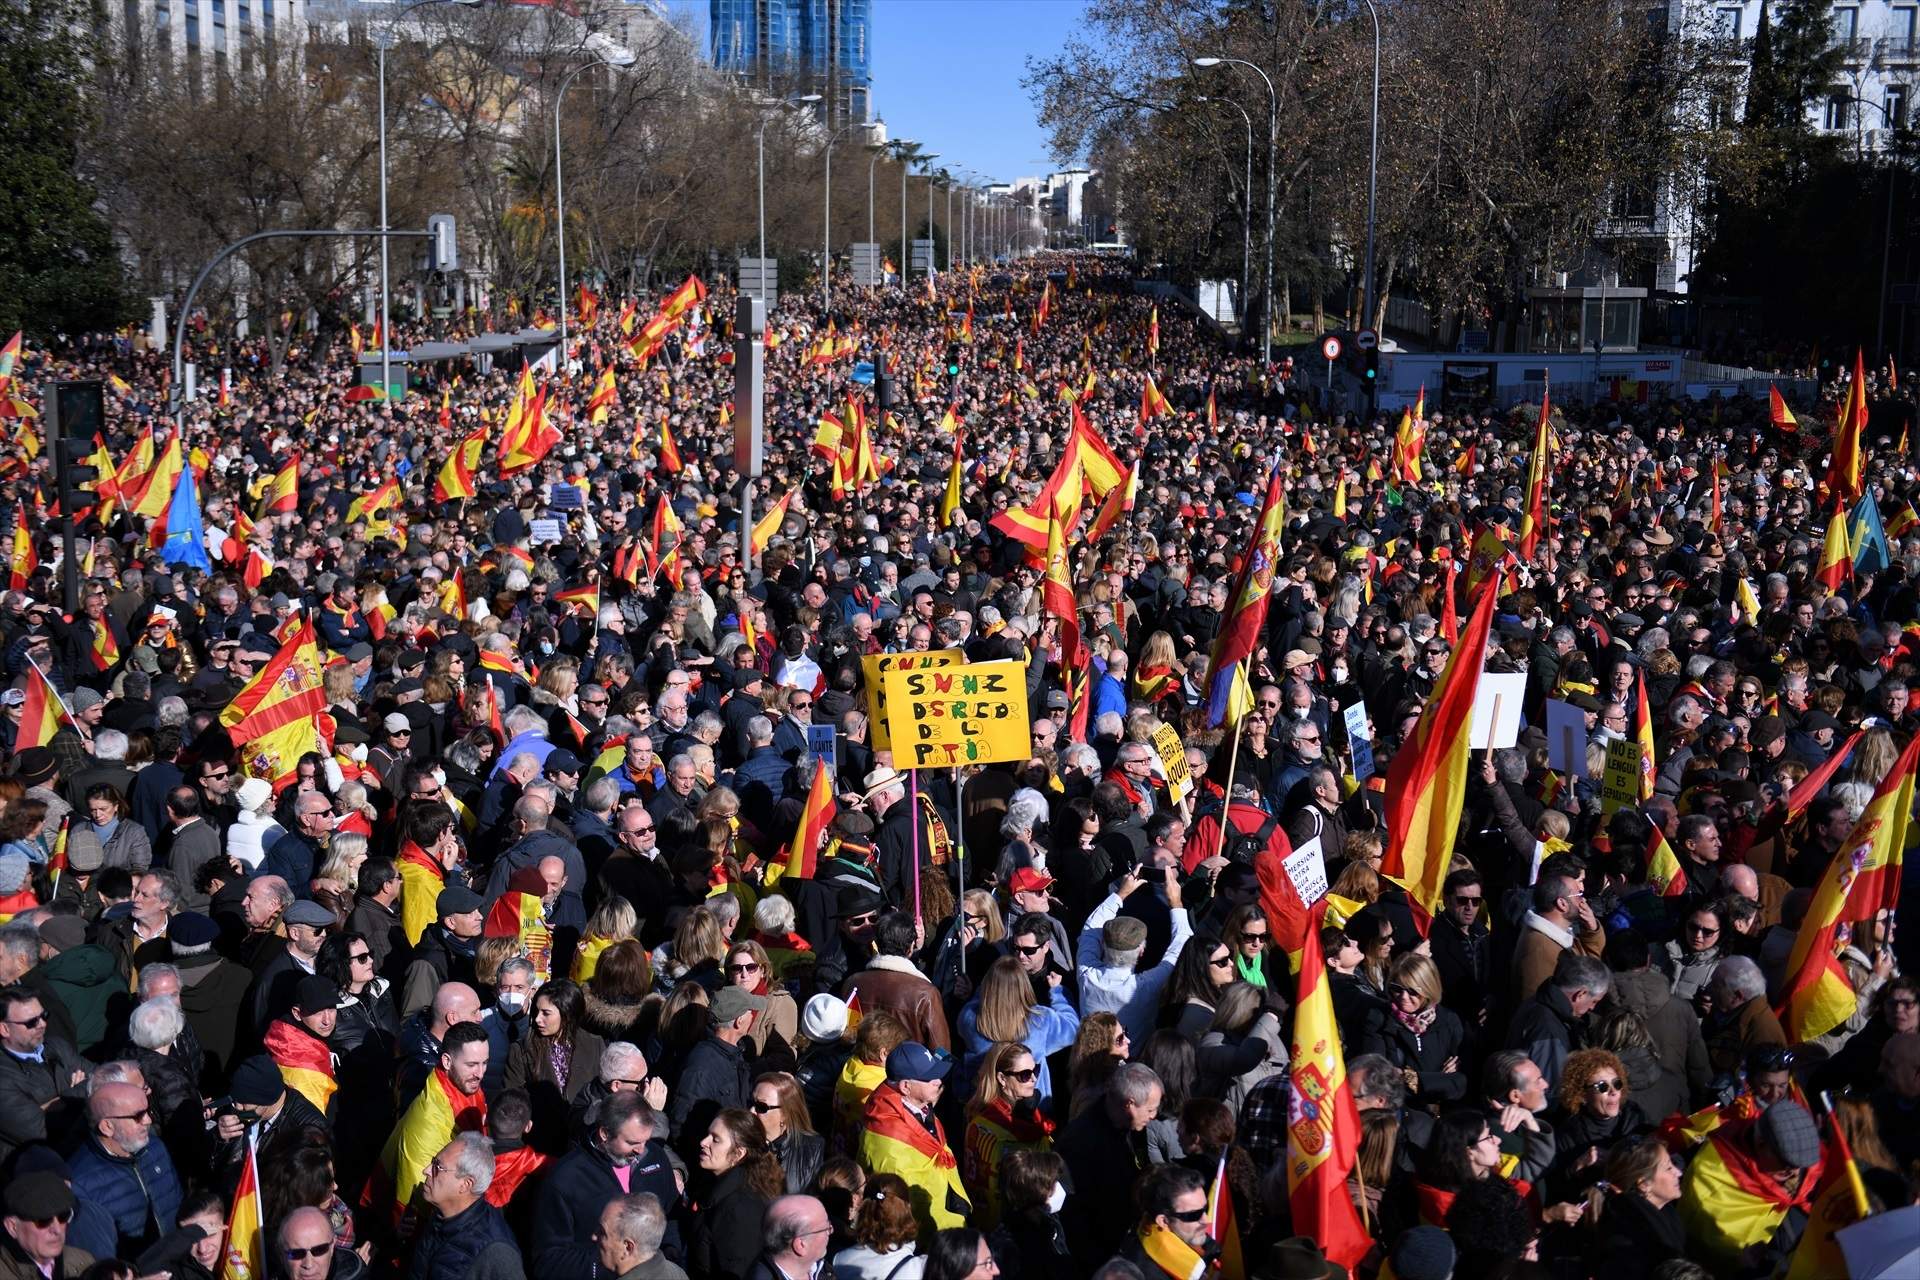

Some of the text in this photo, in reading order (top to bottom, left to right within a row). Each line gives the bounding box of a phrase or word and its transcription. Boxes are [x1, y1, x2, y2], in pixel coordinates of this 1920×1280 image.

[907, 673, 1007, 696] SANCHEZ
[913, 700, 1020, 720] DESTRUCTOR
[918, 720, 984, 740] DE LA
[914, 738, 992, 764] PATRIA
[1611, 740, 1636, 760] NO ES
[1608, 758, 1636, 776] LENGUA
[1616, 776, 1626, 787] ES
